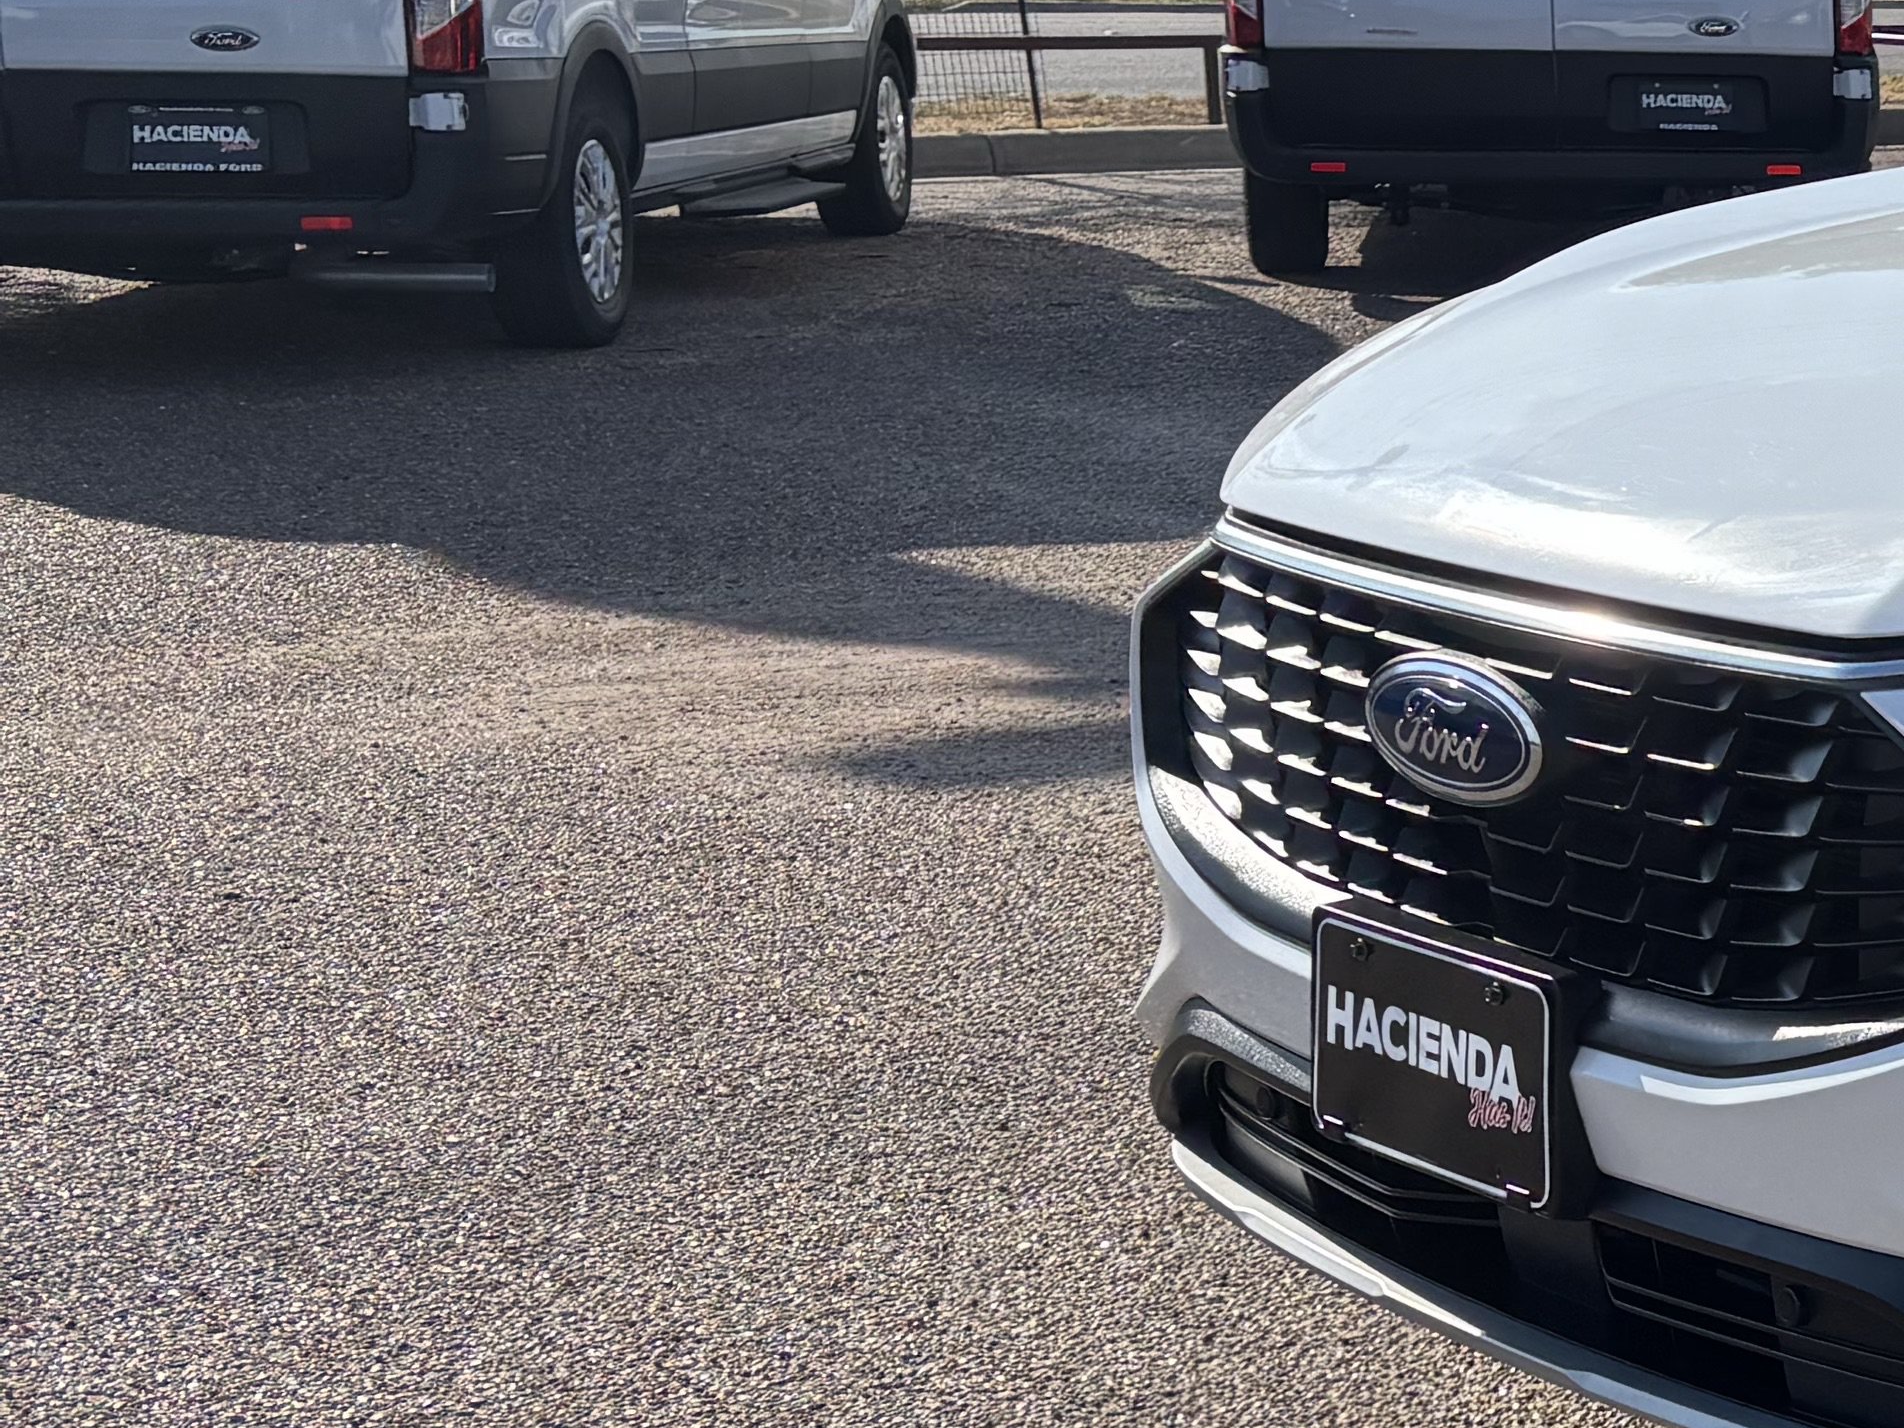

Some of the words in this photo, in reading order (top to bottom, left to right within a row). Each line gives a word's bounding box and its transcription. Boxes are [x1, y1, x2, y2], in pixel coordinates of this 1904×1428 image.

[1641, 93, 1726, 109] HACIENDA
[132, 124, 252, 143] HACIENDA
[1395, 687, 1490, 774] Ford
[1326, 984, 1521, 1106] HACIENDA
